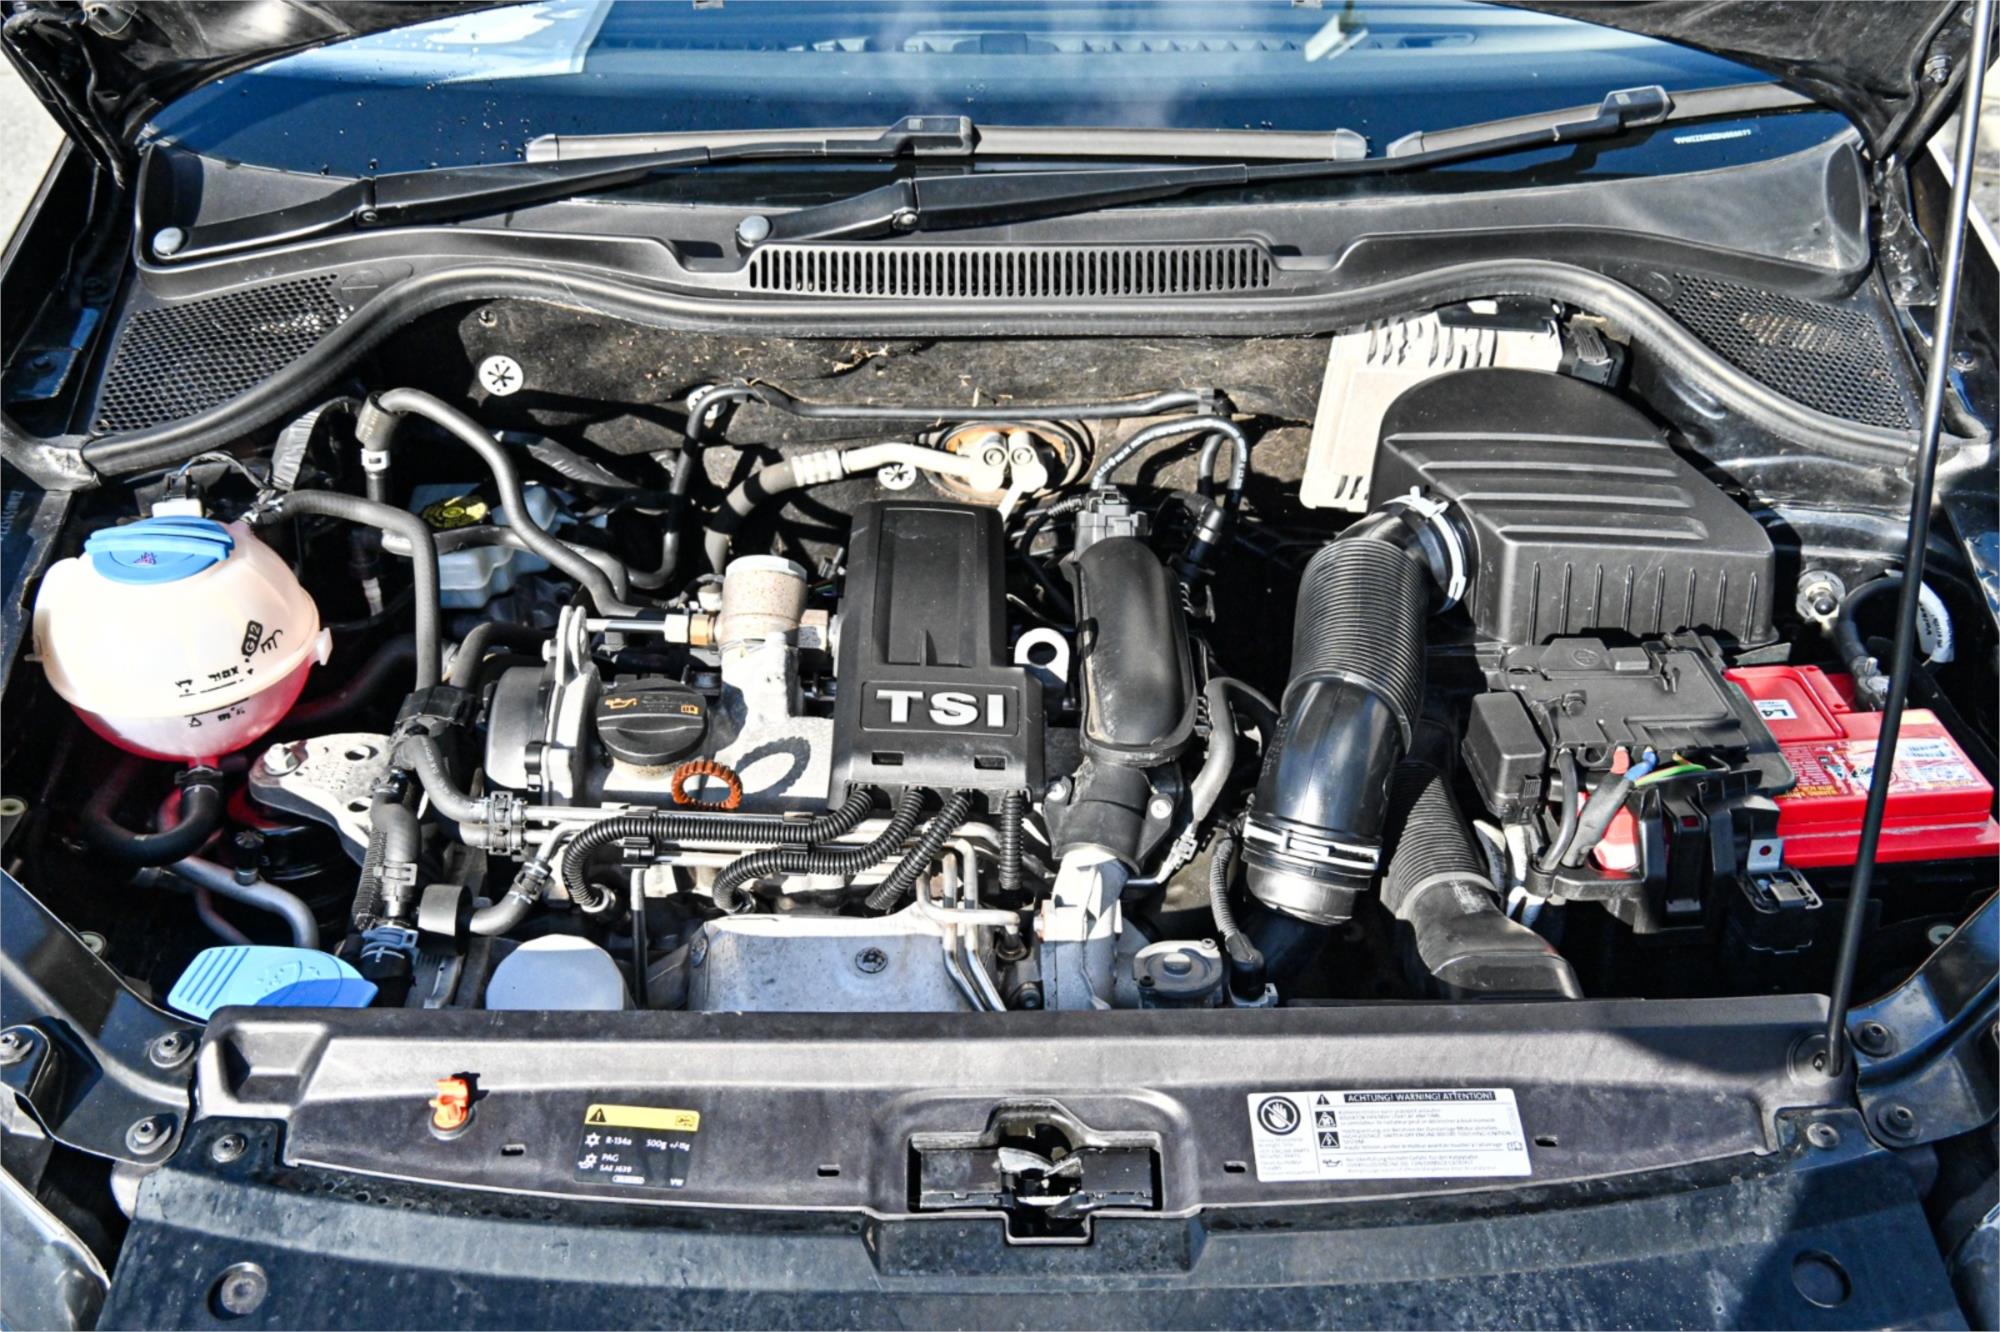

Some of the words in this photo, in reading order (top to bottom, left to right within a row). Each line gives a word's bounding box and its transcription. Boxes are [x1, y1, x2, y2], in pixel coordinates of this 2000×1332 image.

[245, 624, 261, 654] G12
[876, 689, 1005, 727] TSI
[1348, 1093, 1394, 1103] ACHTUNG!
[1396, 1092, 1441, 1102] WARNING!
[1443, 1091, 1493, 1101] ATTENTION!
[605, 1136, 632, 1146] R-134a
[646, 1139, 668, 1151] 500g
[601, 1153, 619, 1162] PAG
[599, 1164, 614, 1172] SAE
[670, 1178, 684, 1187] VW
